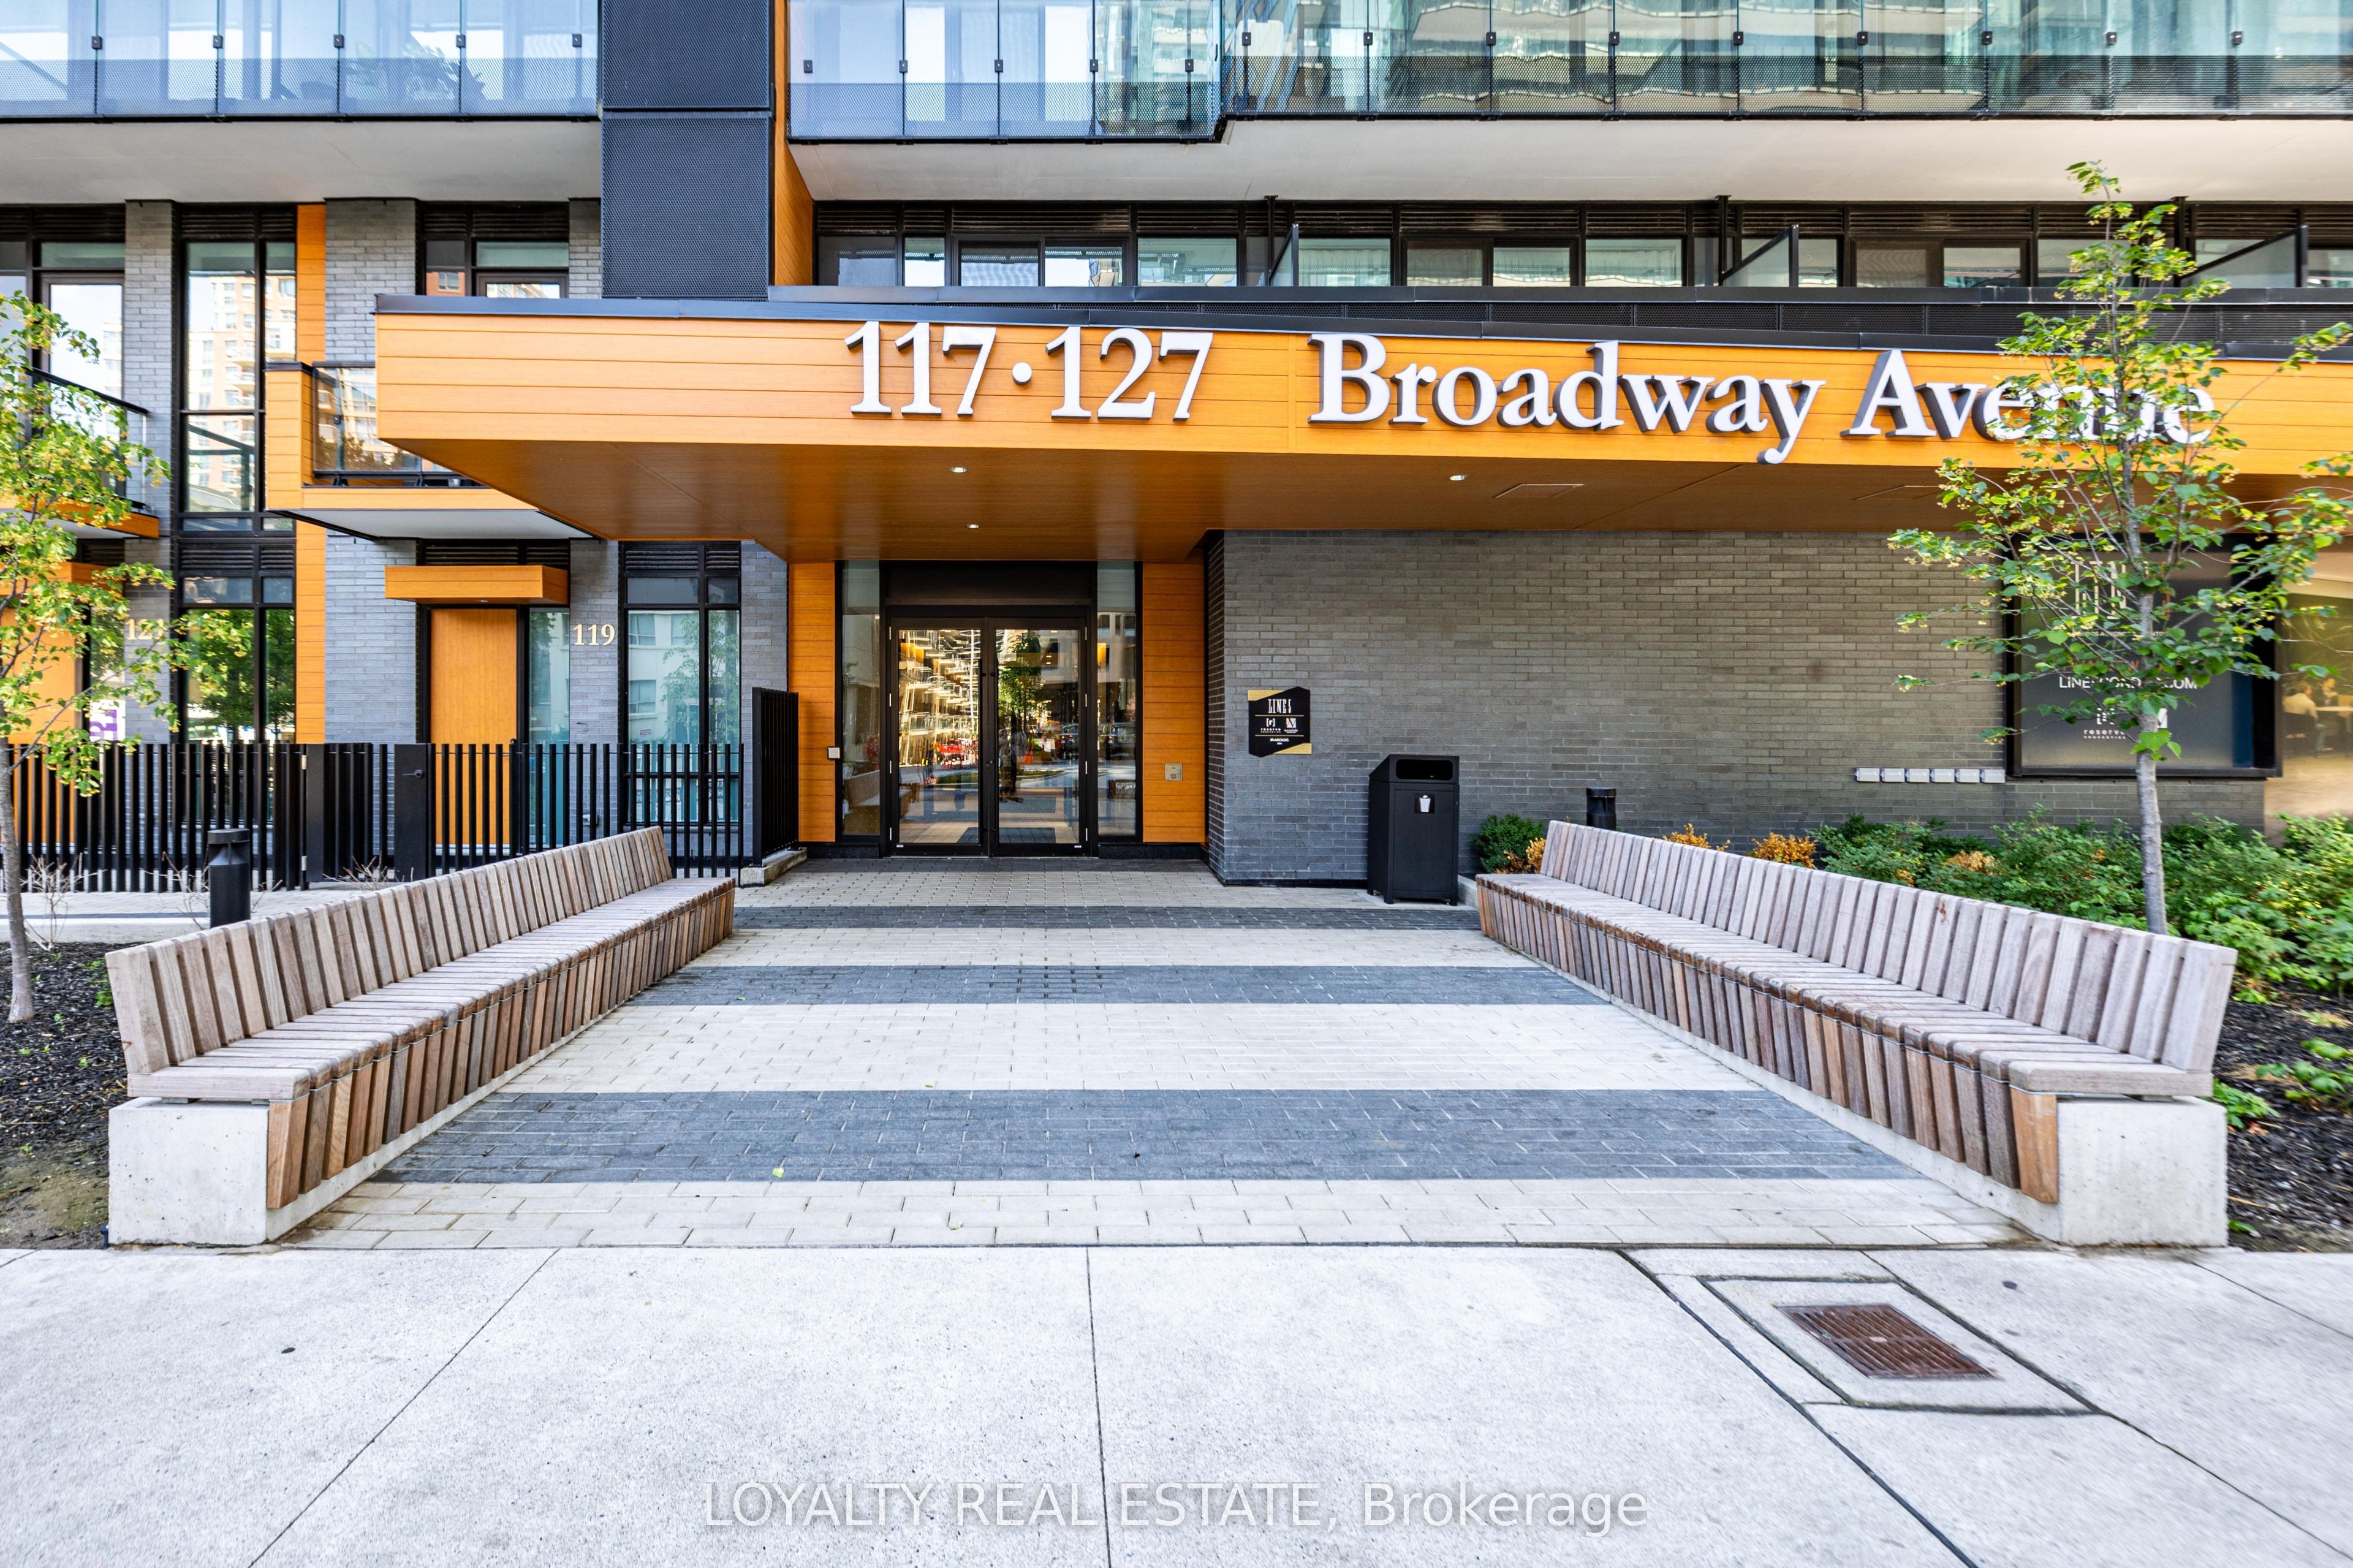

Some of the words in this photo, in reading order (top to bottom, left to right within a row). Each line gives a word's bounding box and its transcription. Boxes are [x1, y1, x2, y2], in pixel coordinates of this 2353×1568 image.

[1307, 333, 1826, 465] Broadway
[1840, 349, 2215, 444] Avenue
[124, 618, 164, 640] 121
[573, 624, 615, 646] 119
